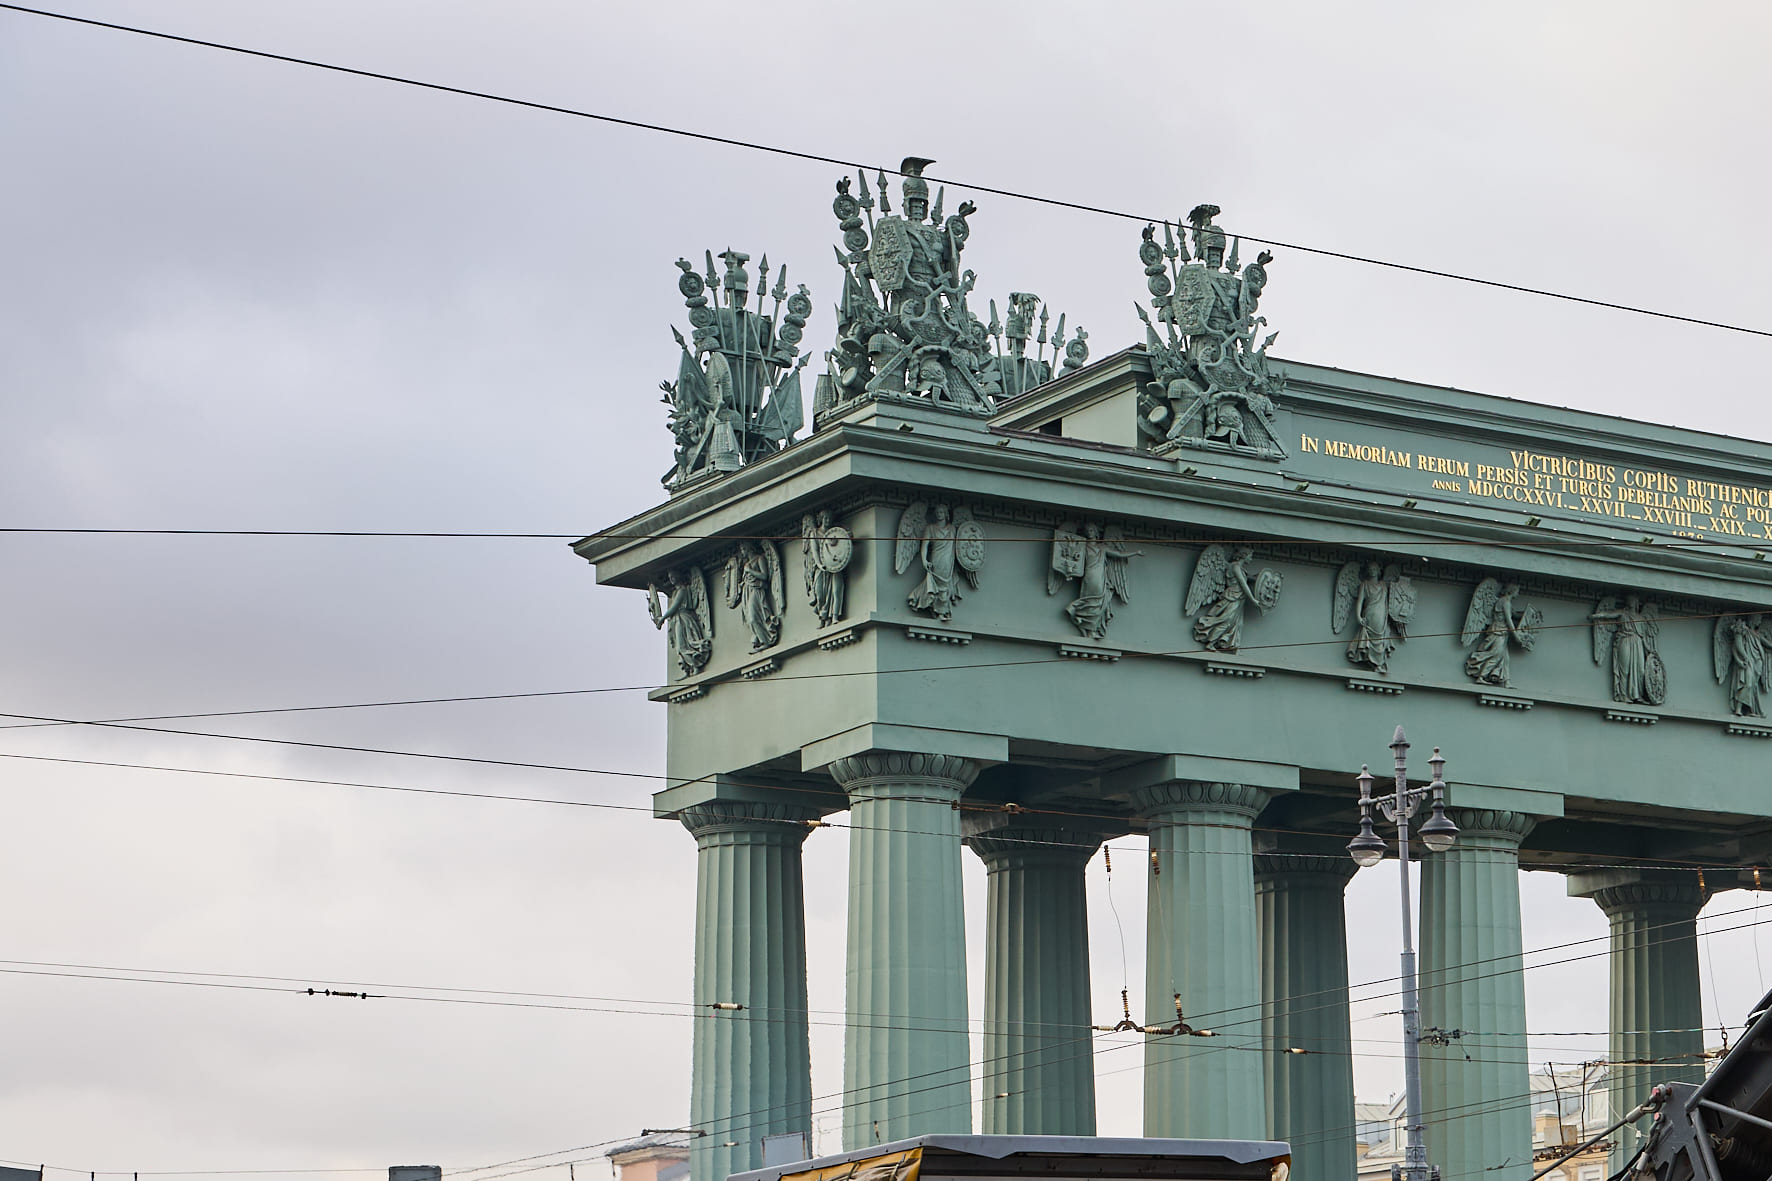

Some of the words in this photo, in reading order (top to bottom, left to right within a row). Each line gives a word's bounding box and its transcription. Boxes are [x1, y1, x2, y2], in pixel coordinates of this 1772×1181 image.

[1301, 433, 1319, 453] IN
[1324, 439, 1411, 468] MEMORIAM
[1417, 454, 1470, 477] RERUM
[1476, 464, 1529, 486] PERSIS
[1534, 474, 1553, 490] ET
[1559, 477, 1612, 499] TURCIS
[1618, 486, 1713, 515] DEBELLANDIS
[1719, 503, 1738, 519] AC
[1510, 450, 1616, 483] VICTRICIBUS
[1623, 469, 1678, 493] COPIIS
